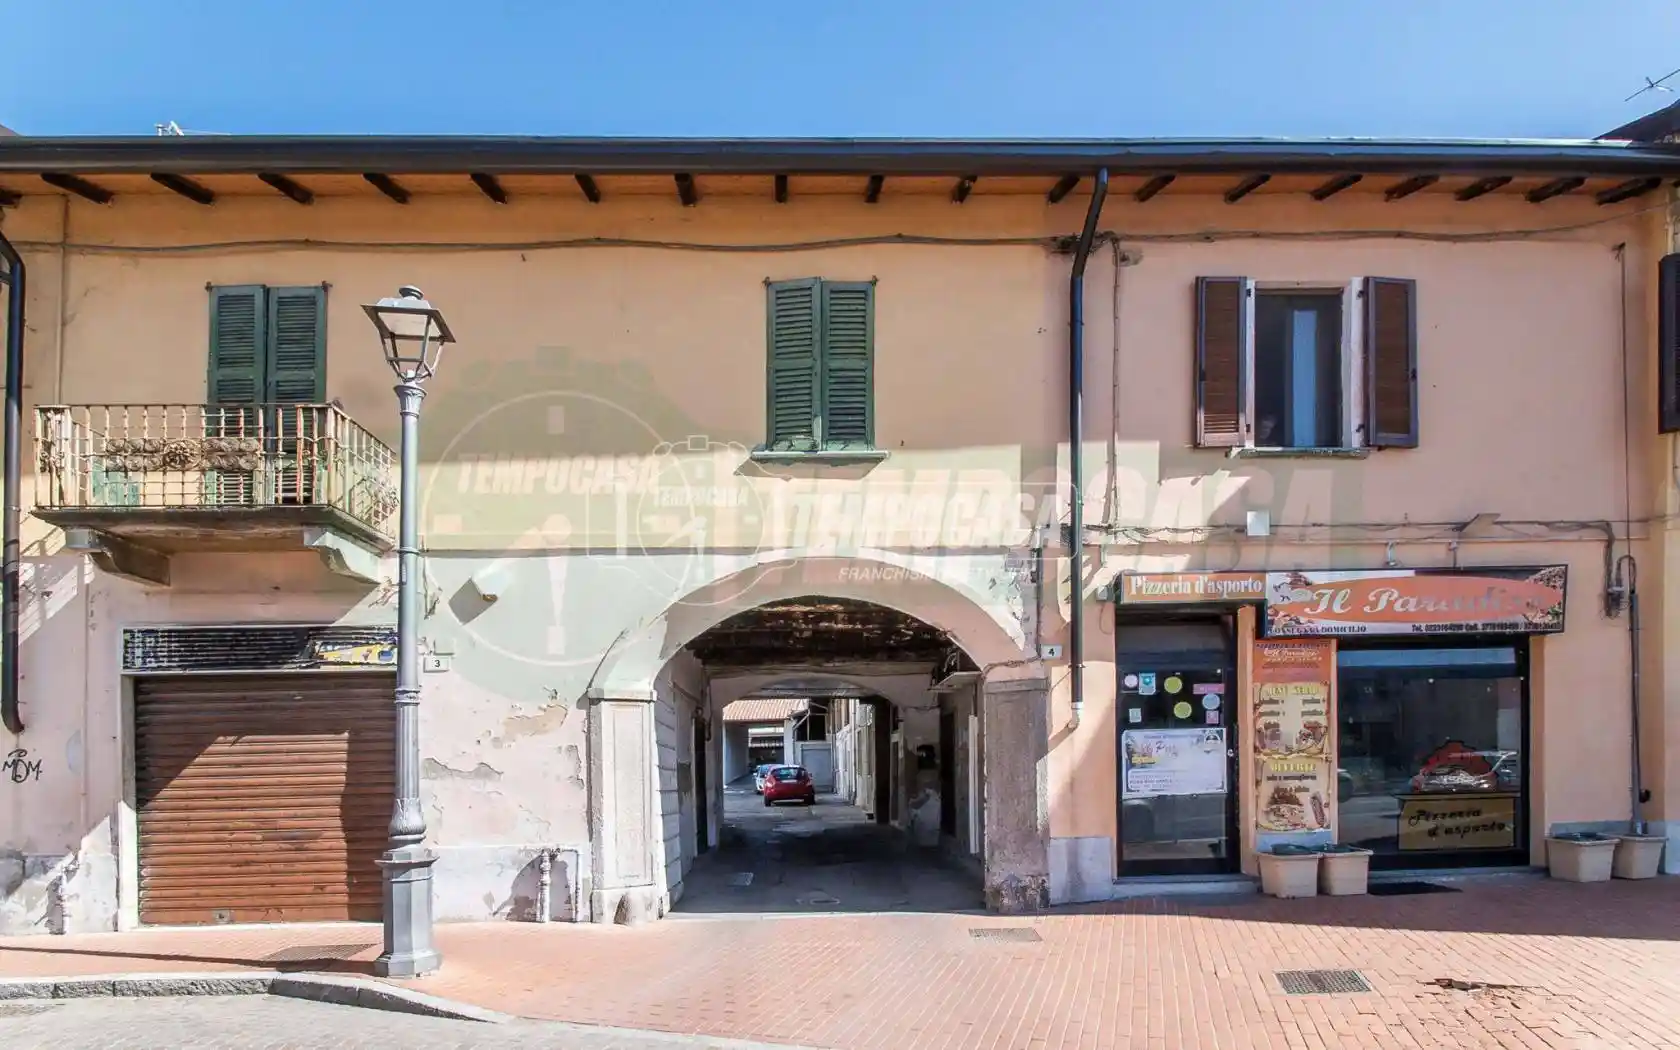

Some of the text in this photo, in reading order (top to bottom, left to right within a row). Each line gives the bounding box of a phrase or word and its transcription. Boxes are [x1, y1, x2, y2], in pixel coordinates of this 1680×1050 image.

[1130, 575, 1263, 599] Pizzeria d'asporto
[1304, 588, 1351, 614] Il
[1048, 647, 1055, 657] 4
[434, 659, 441, 668] 3
